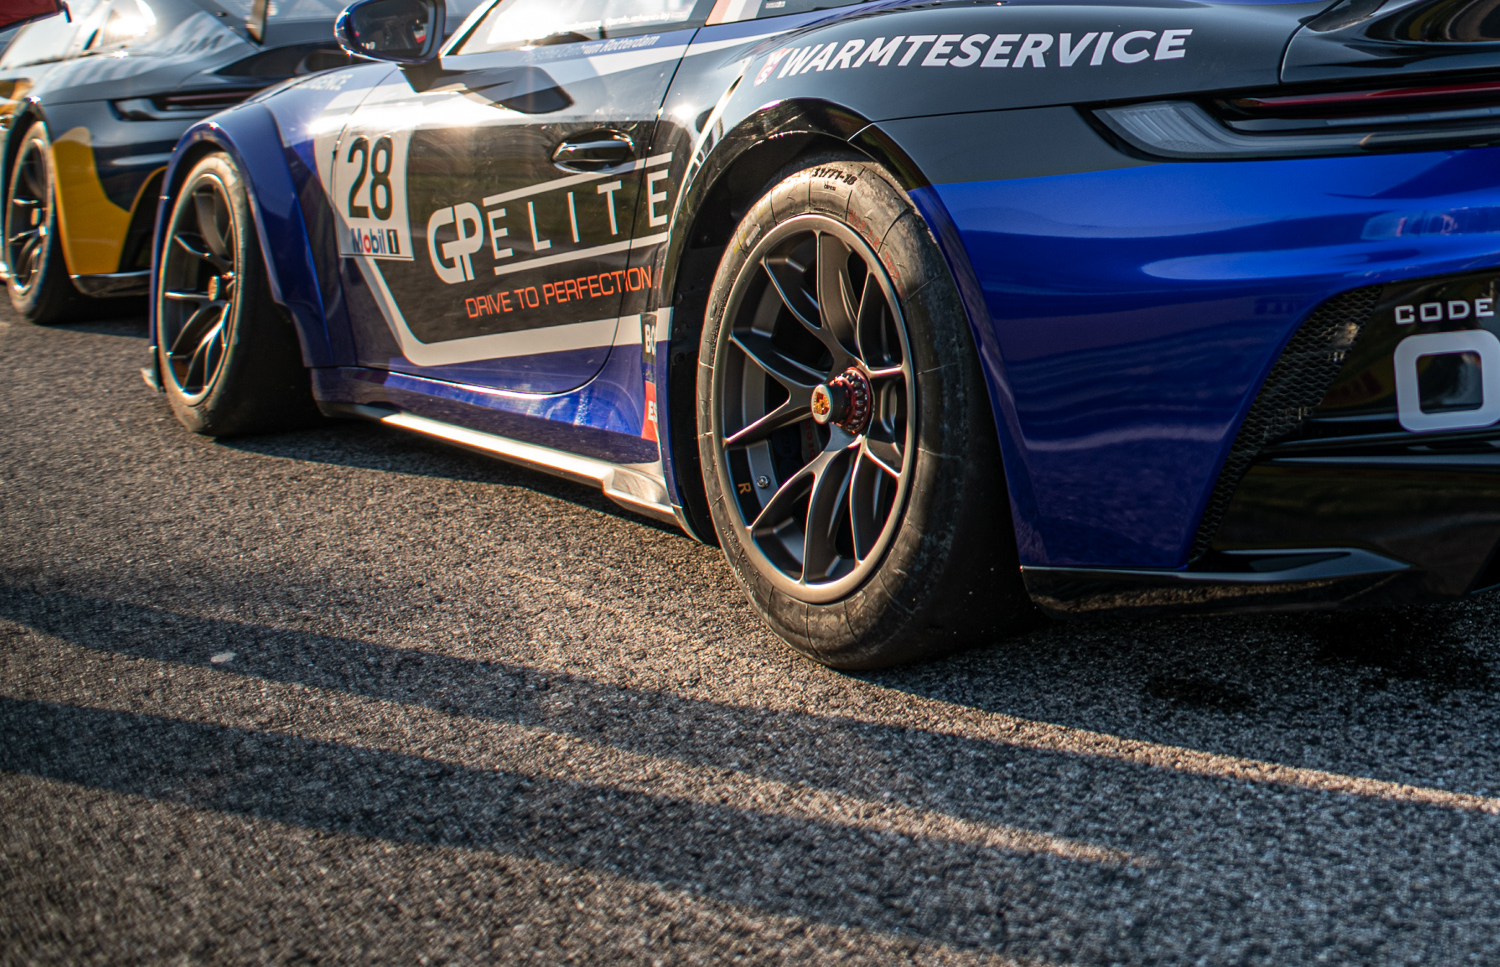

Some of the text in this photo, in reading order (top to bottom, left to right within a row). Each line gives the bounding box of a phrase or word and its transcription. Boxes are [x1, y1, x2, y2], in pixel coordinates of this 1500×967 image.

[600, 35, 660, 54] Rotterdam
[777, 28, 1193, 79] WARMTESERVICE
[347, 135, 394, 221] 28
[487, 169, 669, 260] ELITE
[350, 228, 387, 254] Mobil
[465, 265, 652, 318] DRIVE TO PERFECTION
[1395, 297, 1494, 325] CODE
